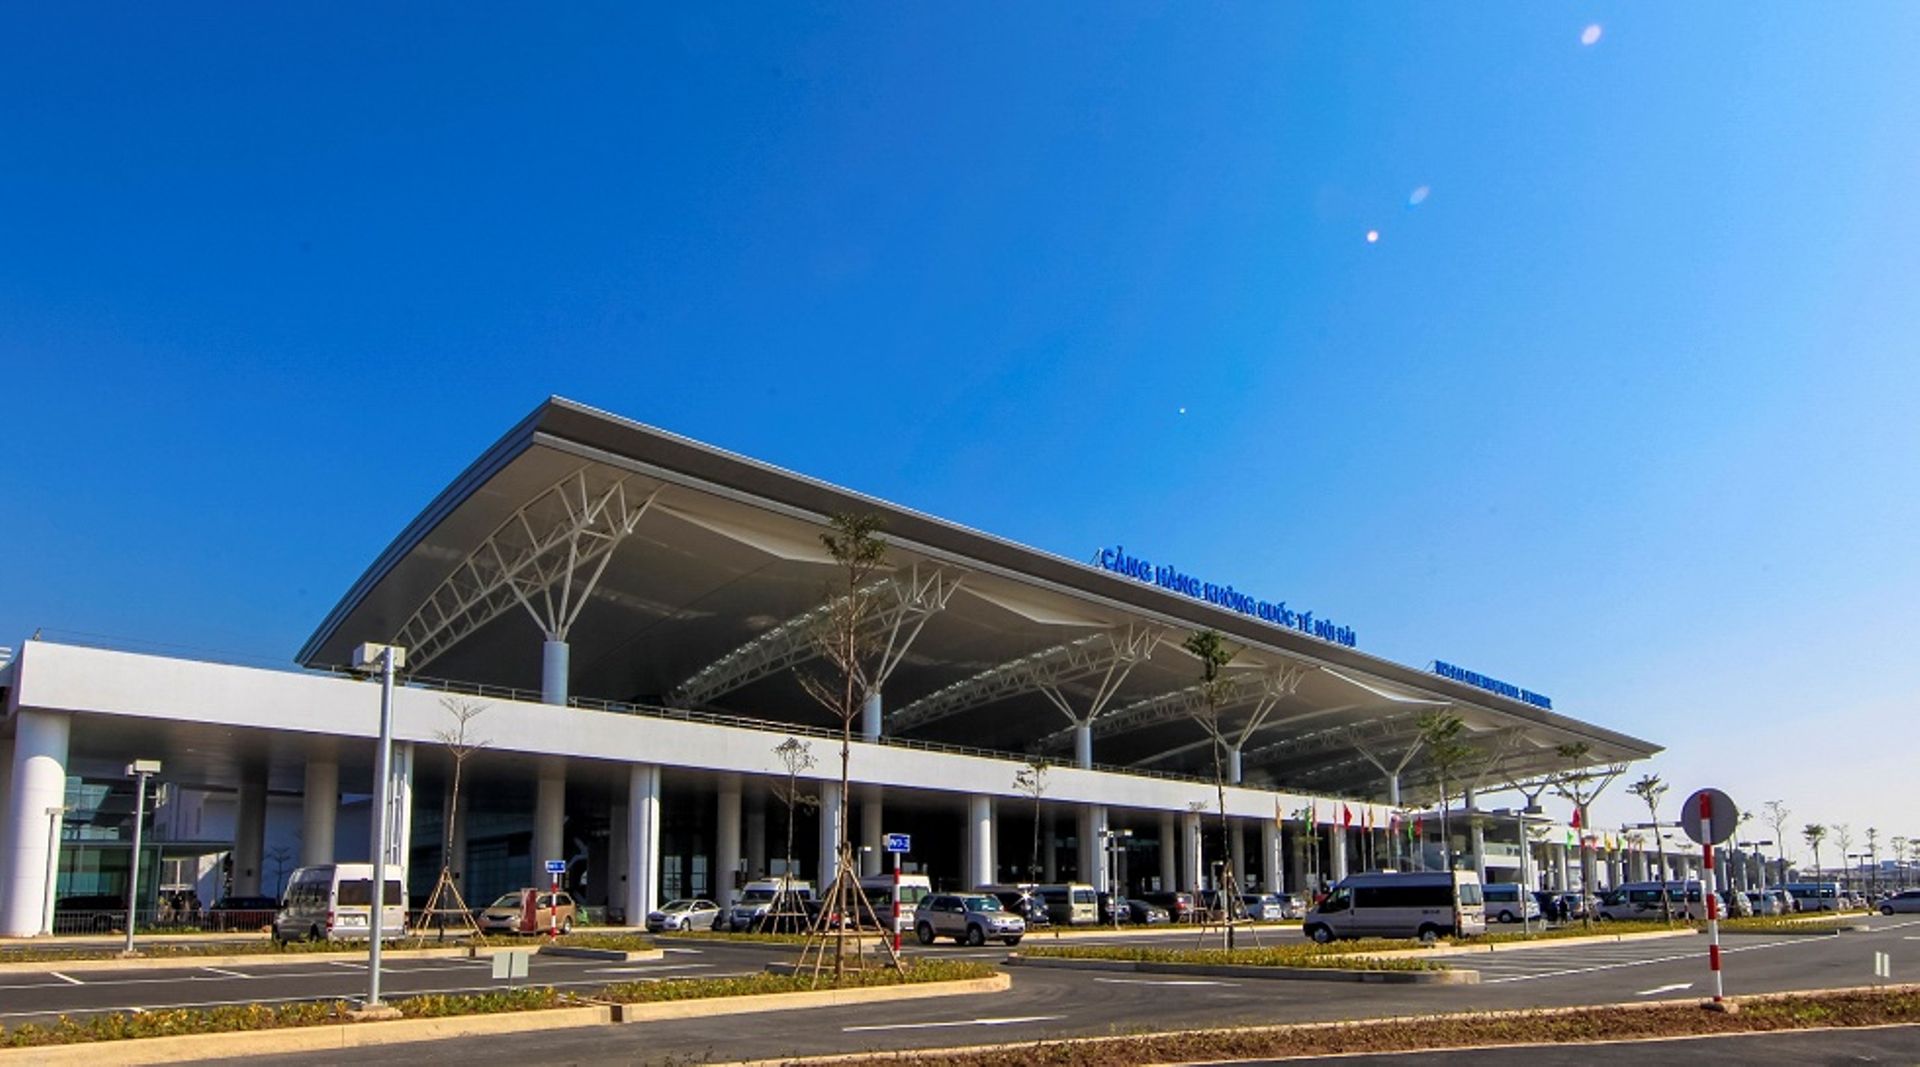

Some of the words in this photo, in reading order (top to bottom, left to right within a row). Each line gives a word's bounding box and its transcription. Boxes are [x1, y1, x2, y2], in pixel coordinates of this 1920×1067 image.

[1155, 565, 1202, 598] HÀNG
[1203, 582, 1257, 617] KHÔNG
[1257, 601, 1296, 628] QUỐC
[1296, 610, 1314, 634] TẾ
